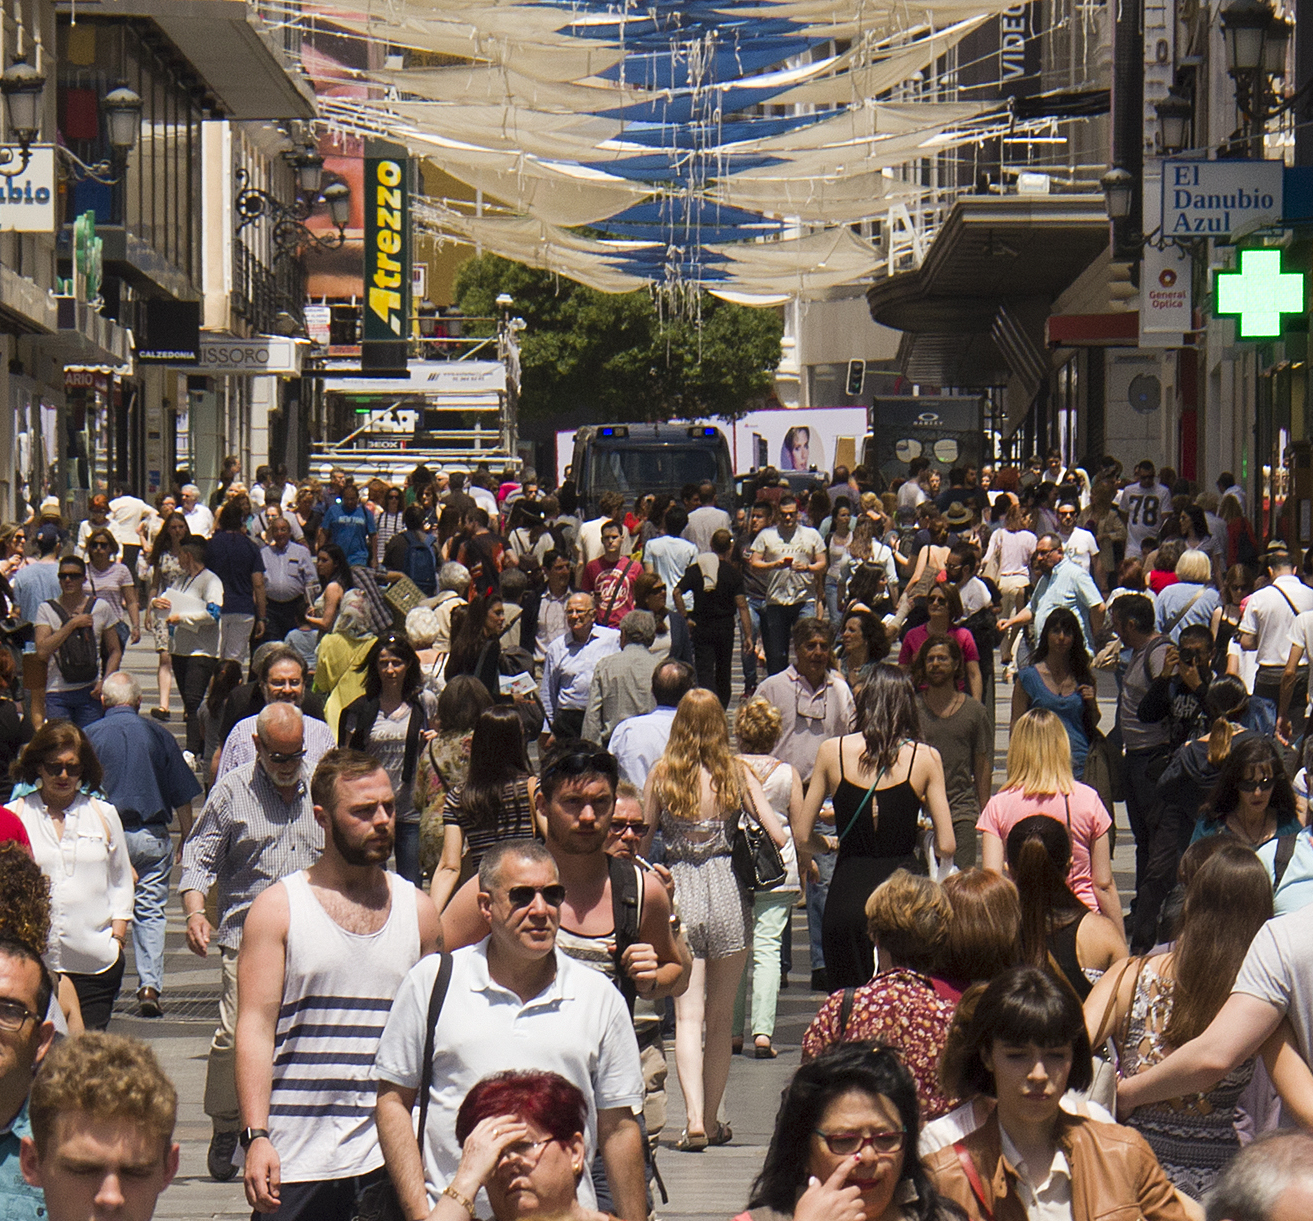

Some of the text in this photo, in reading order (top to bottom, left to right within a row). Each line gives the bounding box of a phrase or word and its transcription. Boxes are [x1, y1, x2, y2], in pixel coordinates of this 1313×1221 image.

[1173, 165, 1200, 186] El
[1173, 188, 1274, 209] Danubio
[1172, 212, 1232, 232] Azul
[368, 160, 402, 336] Atrezzo
[1149, 290, 1187, 299] General
[138, 350, 197, 360] CALZEDONIA
[1128, 494, 1160, 527] 78
